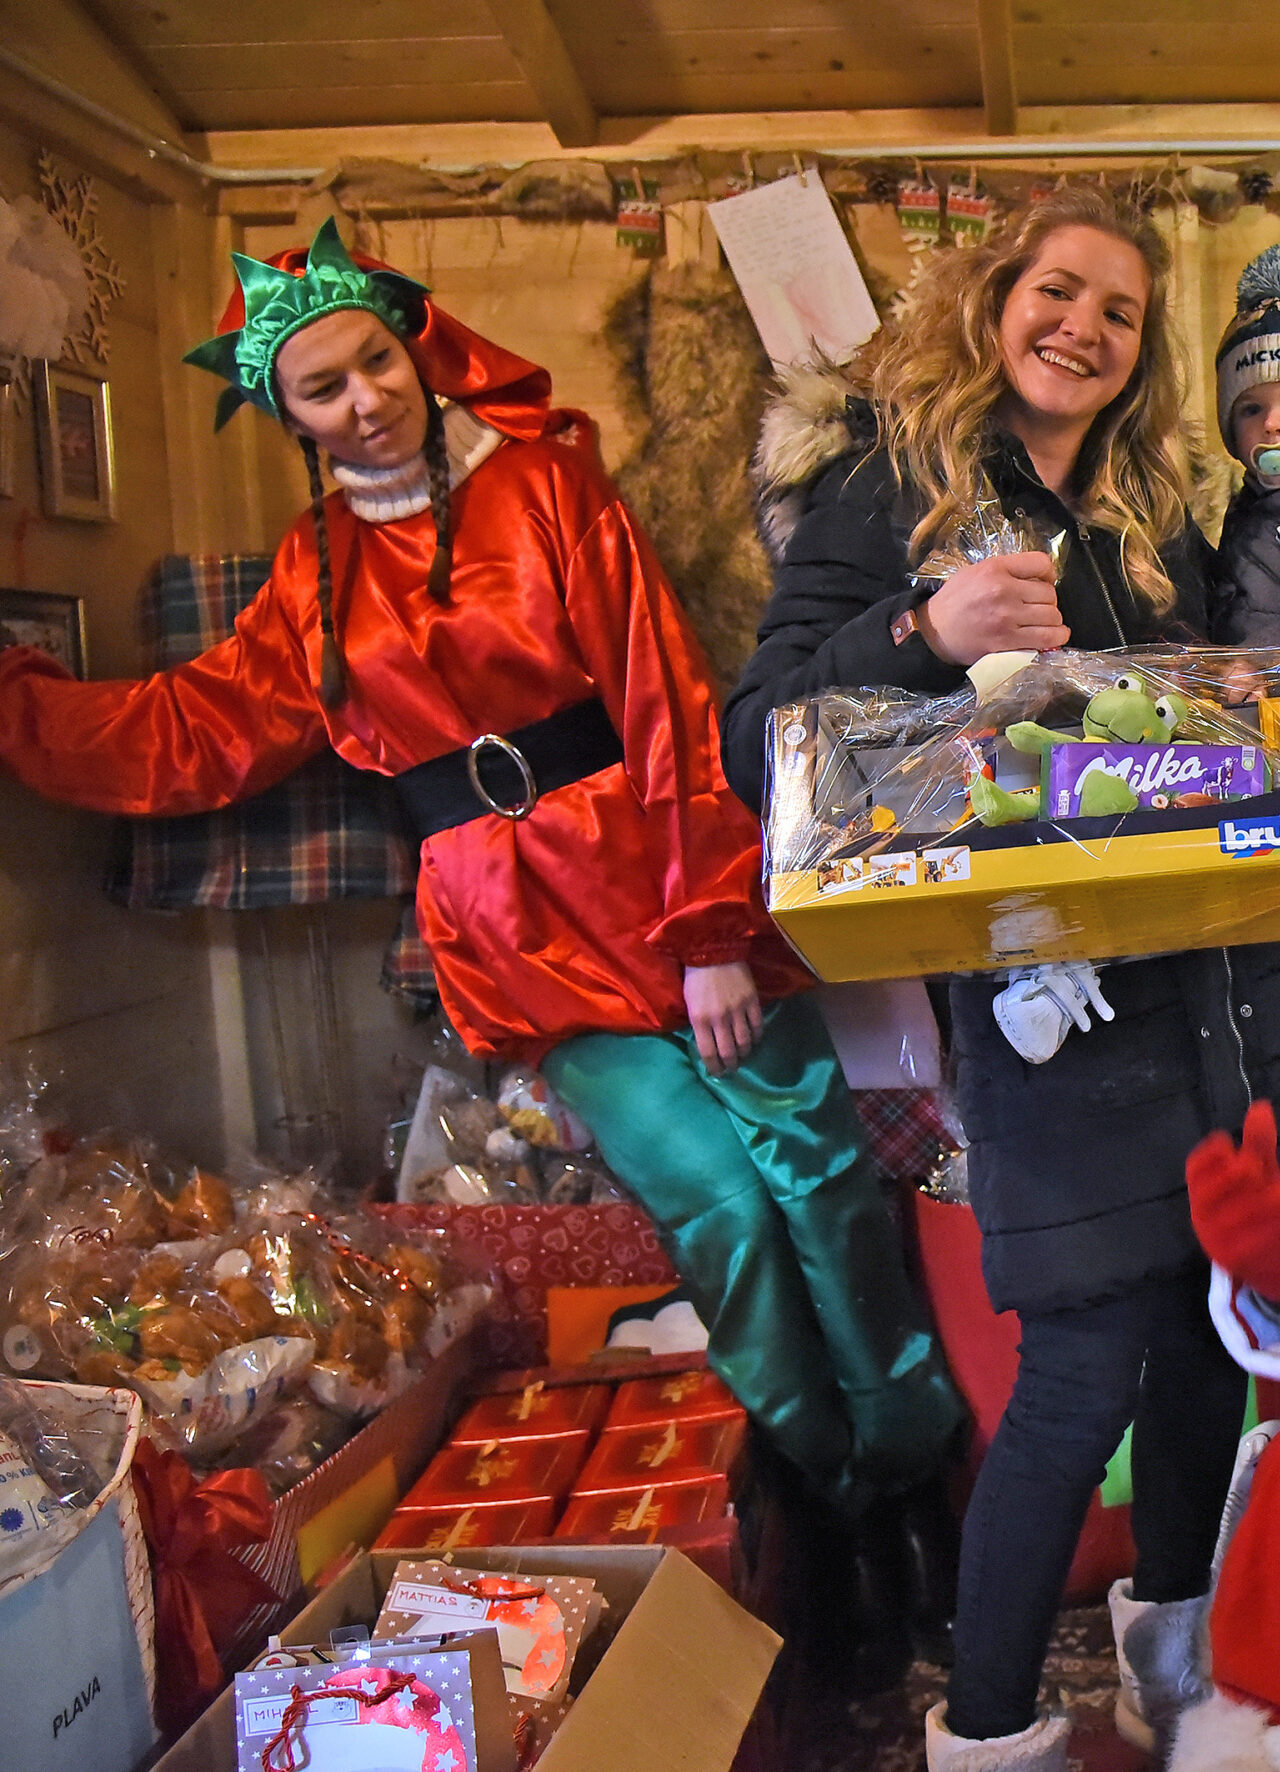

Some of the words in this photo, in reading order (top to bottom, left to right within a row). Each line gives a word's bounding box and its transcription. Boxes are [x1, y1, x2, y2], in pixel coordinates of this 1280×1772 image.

[1073, 747, 1208, 797] Milka
[400, 1590, 458, 1606] MATTIAS
[52, 1675, 101, 1738] PLAVA
[254, 1703, 319, 1721] MIHL
